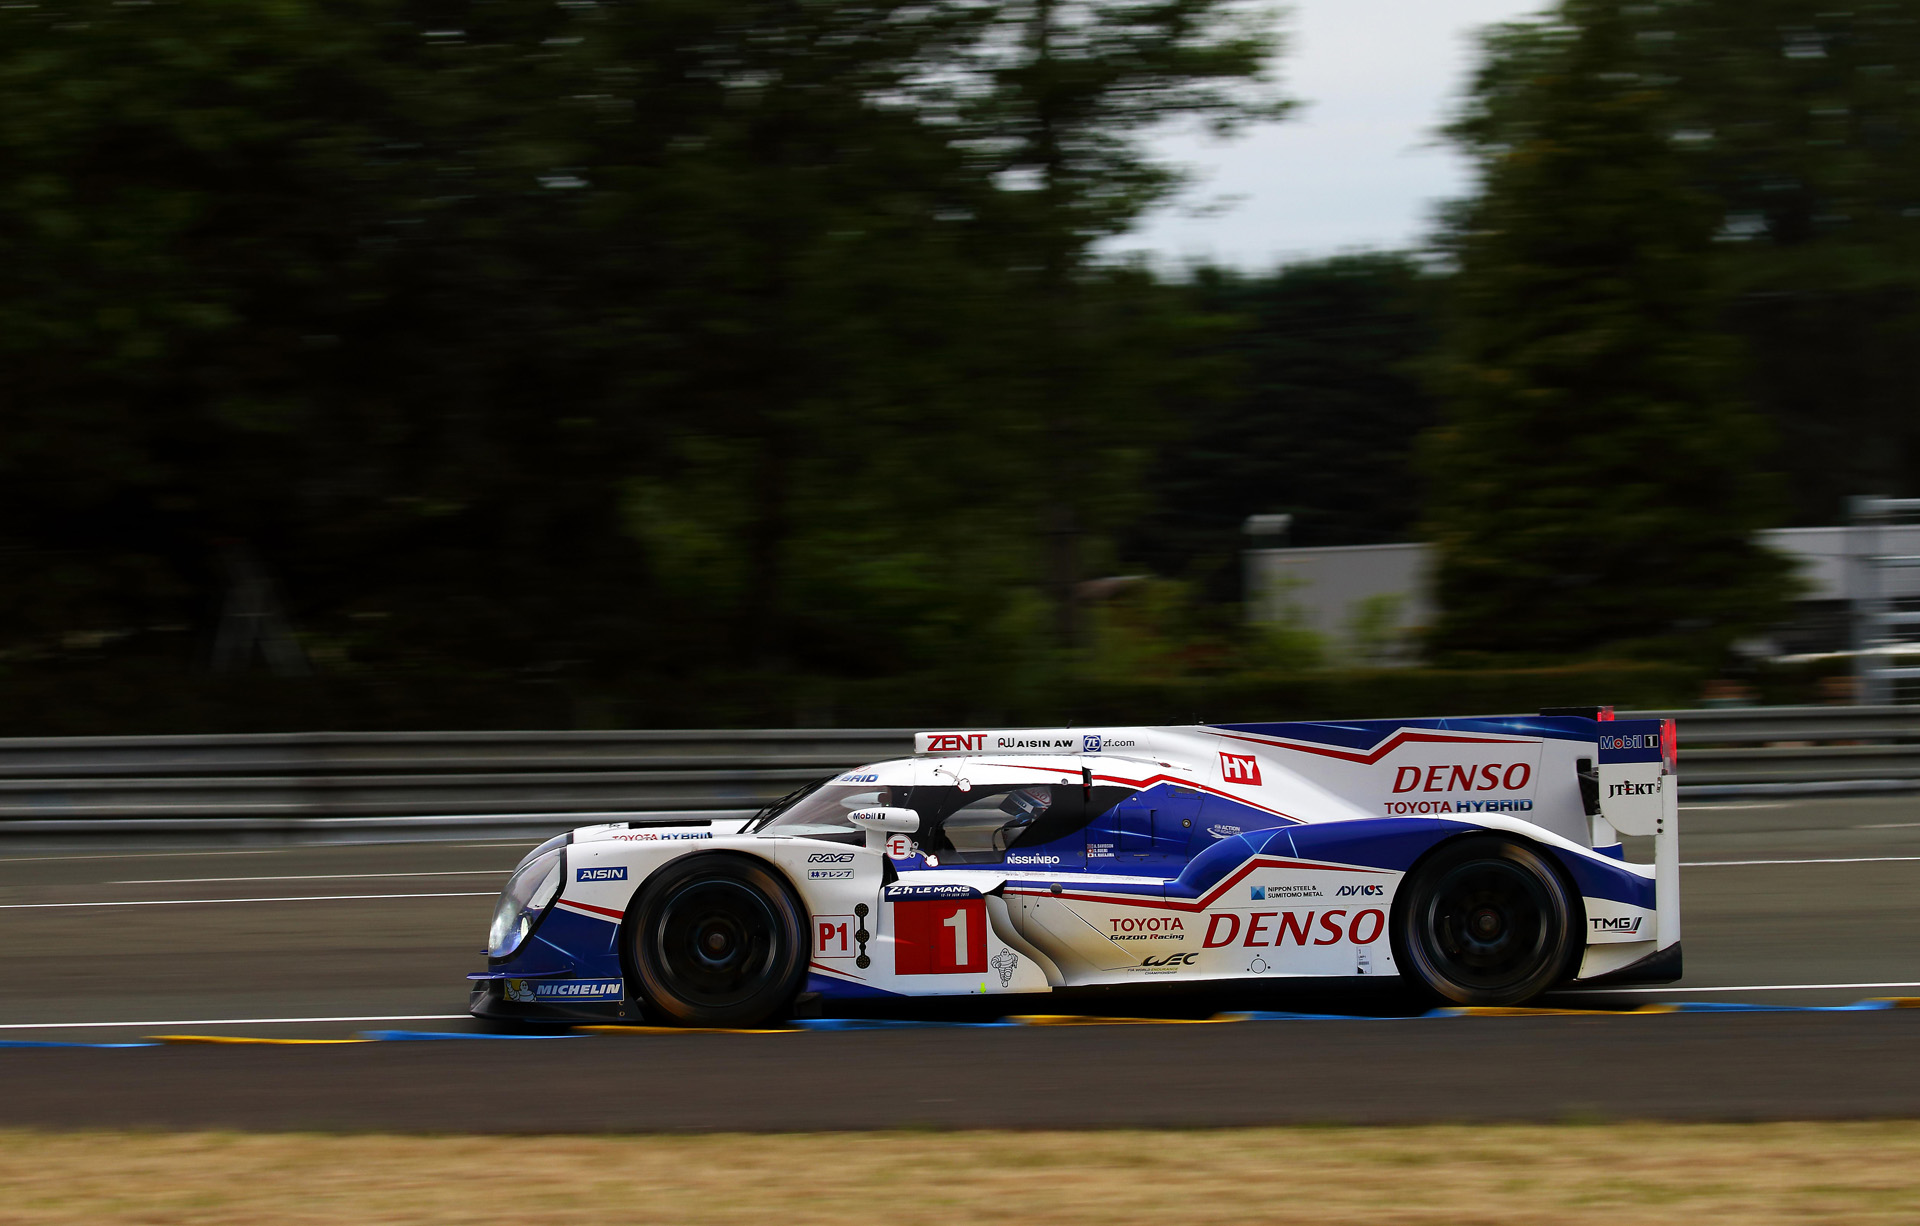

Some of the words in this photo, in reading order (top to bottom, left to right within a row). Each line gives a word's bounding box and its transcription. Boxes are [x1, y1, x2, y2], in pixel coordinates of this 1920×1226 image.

[927, 734, 987, 752] ZENT
[1017, 739, 1051, 748] AISIN
[1054, 739, 1073, 748] AW
[1086, 738, 1098, 749] ZF
[1103, 738, 1135, 747] zf.com
[1600, 735, 1642, 749] Mobil
[1221, 755, 1254, 779] HY
[1392, 763, 1531, 793] DENSO
[1608, 783, 1655, 798] JTEKT
[1384, 801, 1452, 814] TOYOTA
[1456, 799, 1533, 813] HYBRID
[853, 812, 876, 820] Mobil
[893, 840, 905, 855] E
[808, 853, 855, 862] RAYS
[580, 869, 624, 880] AISIN
[916, 886, 932, 894] LE
[1335, 885, 1383, 896] ADVICS
[1110, 918, 1184, 932] TOYOTA
[1202, 909, 1385, 948] DENSO
[1589, 917, 1630, 929] TMG
[819, 922, 848, 951] P1
[944, 909, 968, 966] 1
[1149, 933, 1184, 941] Racing
[1142, 952, 1199, 966] WEC
[537, 984, 620, 995] MICHELIN
